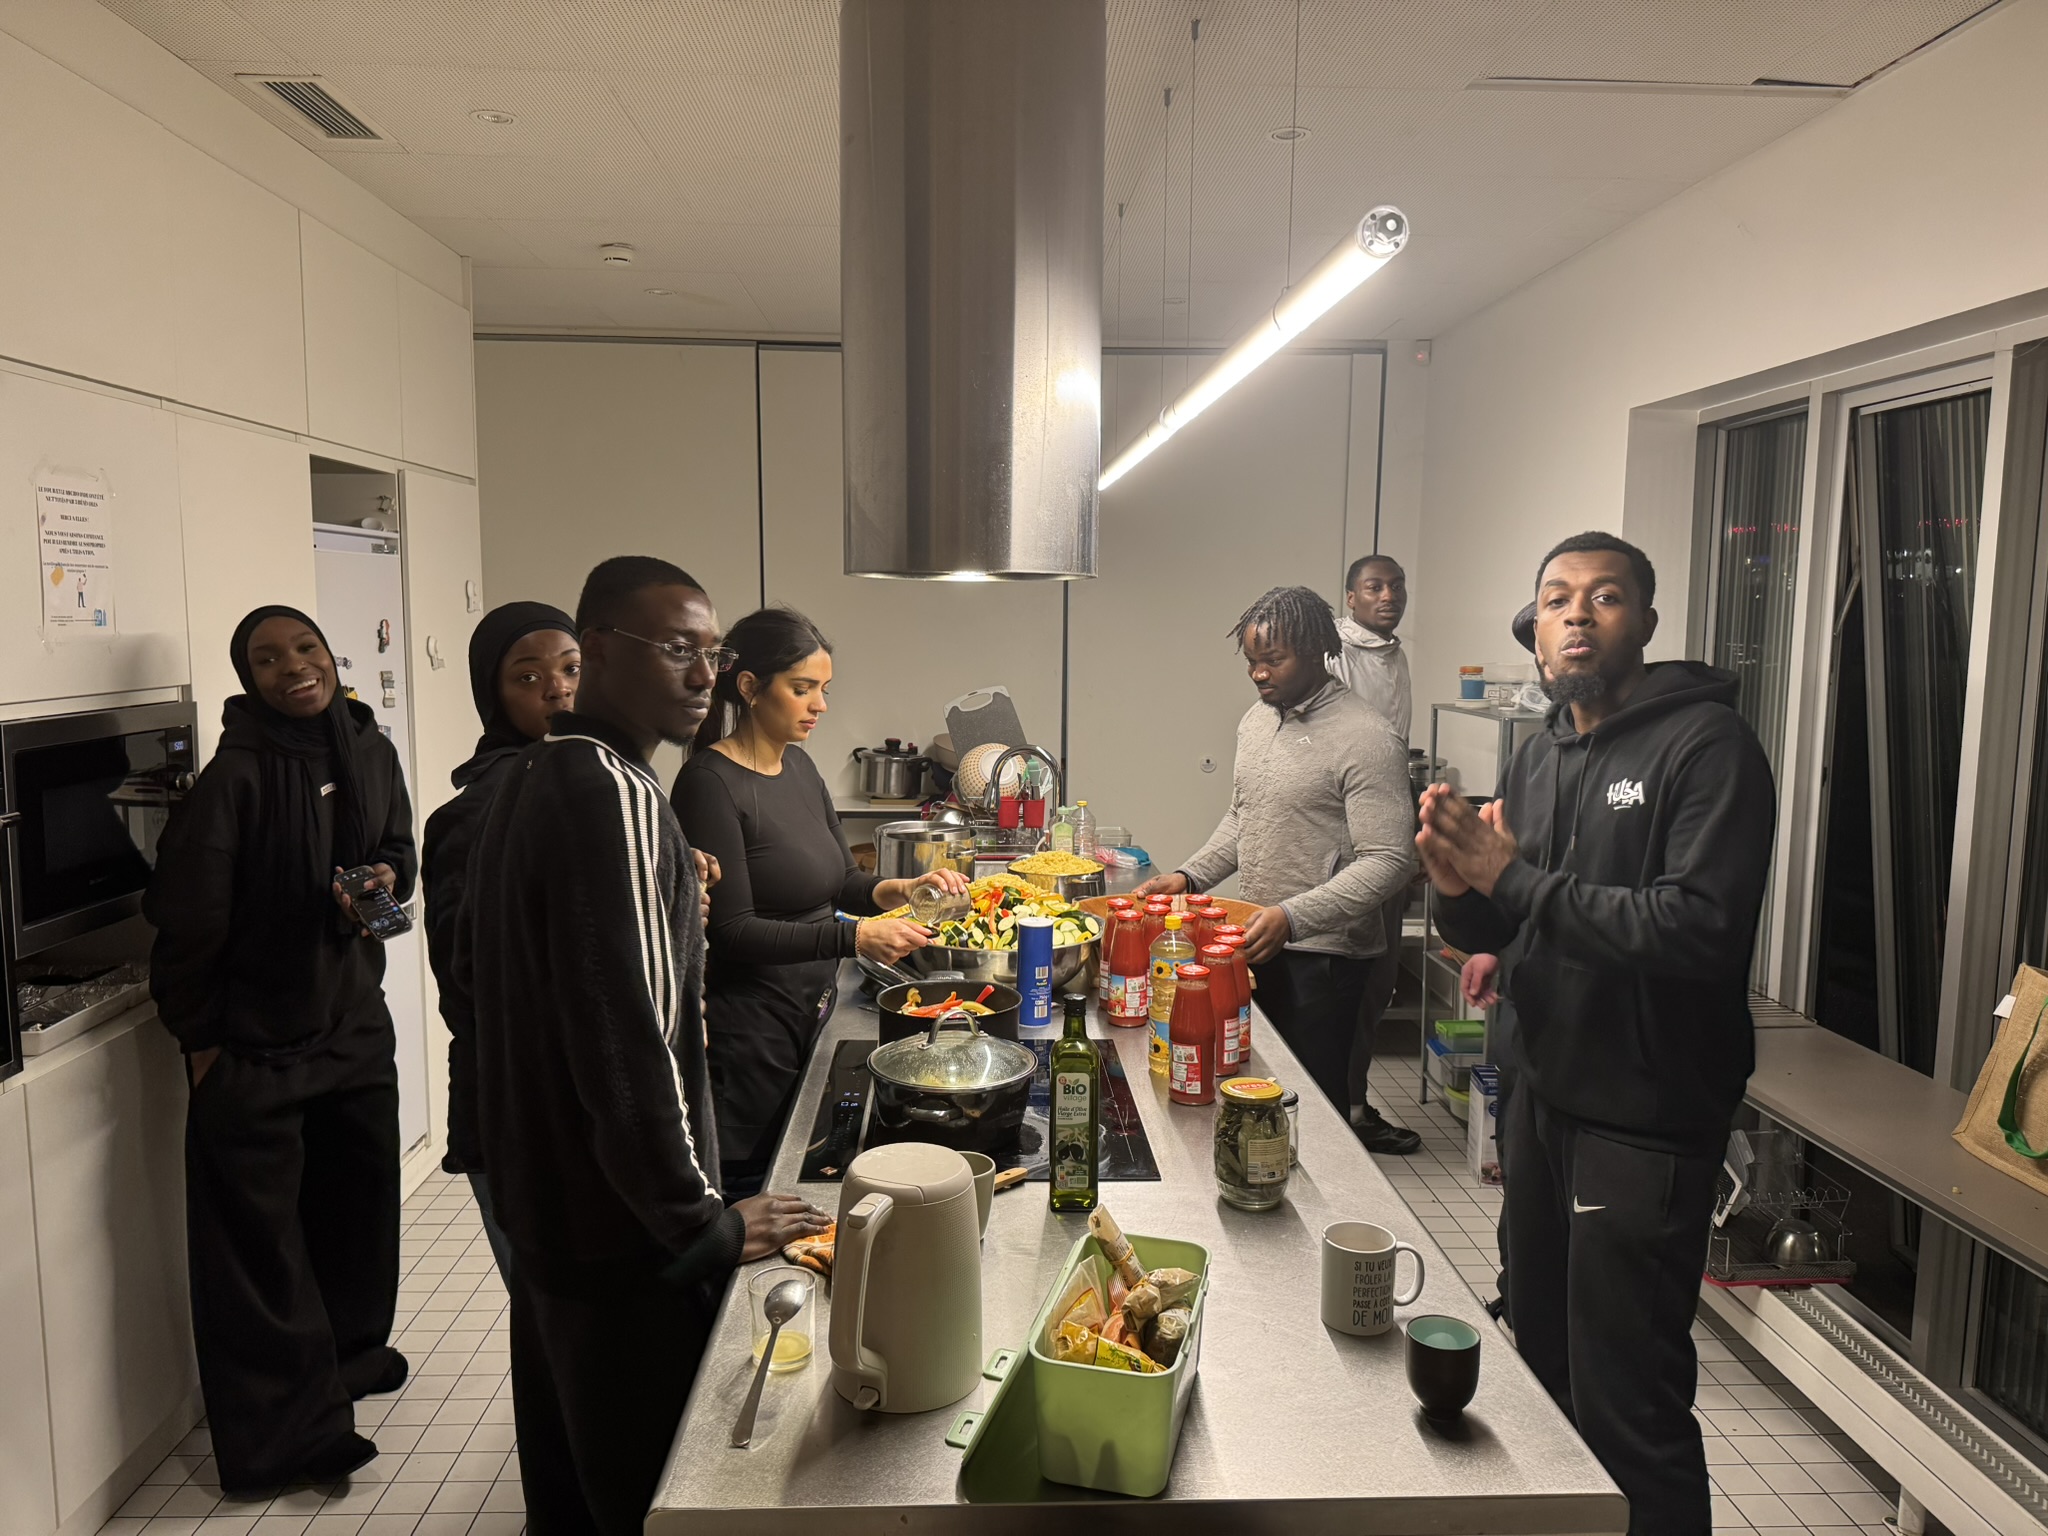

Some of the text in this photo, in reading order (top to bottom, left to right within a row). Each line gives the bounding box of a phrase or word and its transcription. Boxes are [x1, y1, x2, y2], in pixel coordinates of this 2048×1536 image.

[1063, 1095, 1087, 1103] village
[1354, 1261, 1361, 1271] SI
[1365, 1261, 1375, 1272] TU
[1353, 1299, 1371, 1309] PASSE
[1353, 1306, 1390, 1327] DE MOI
